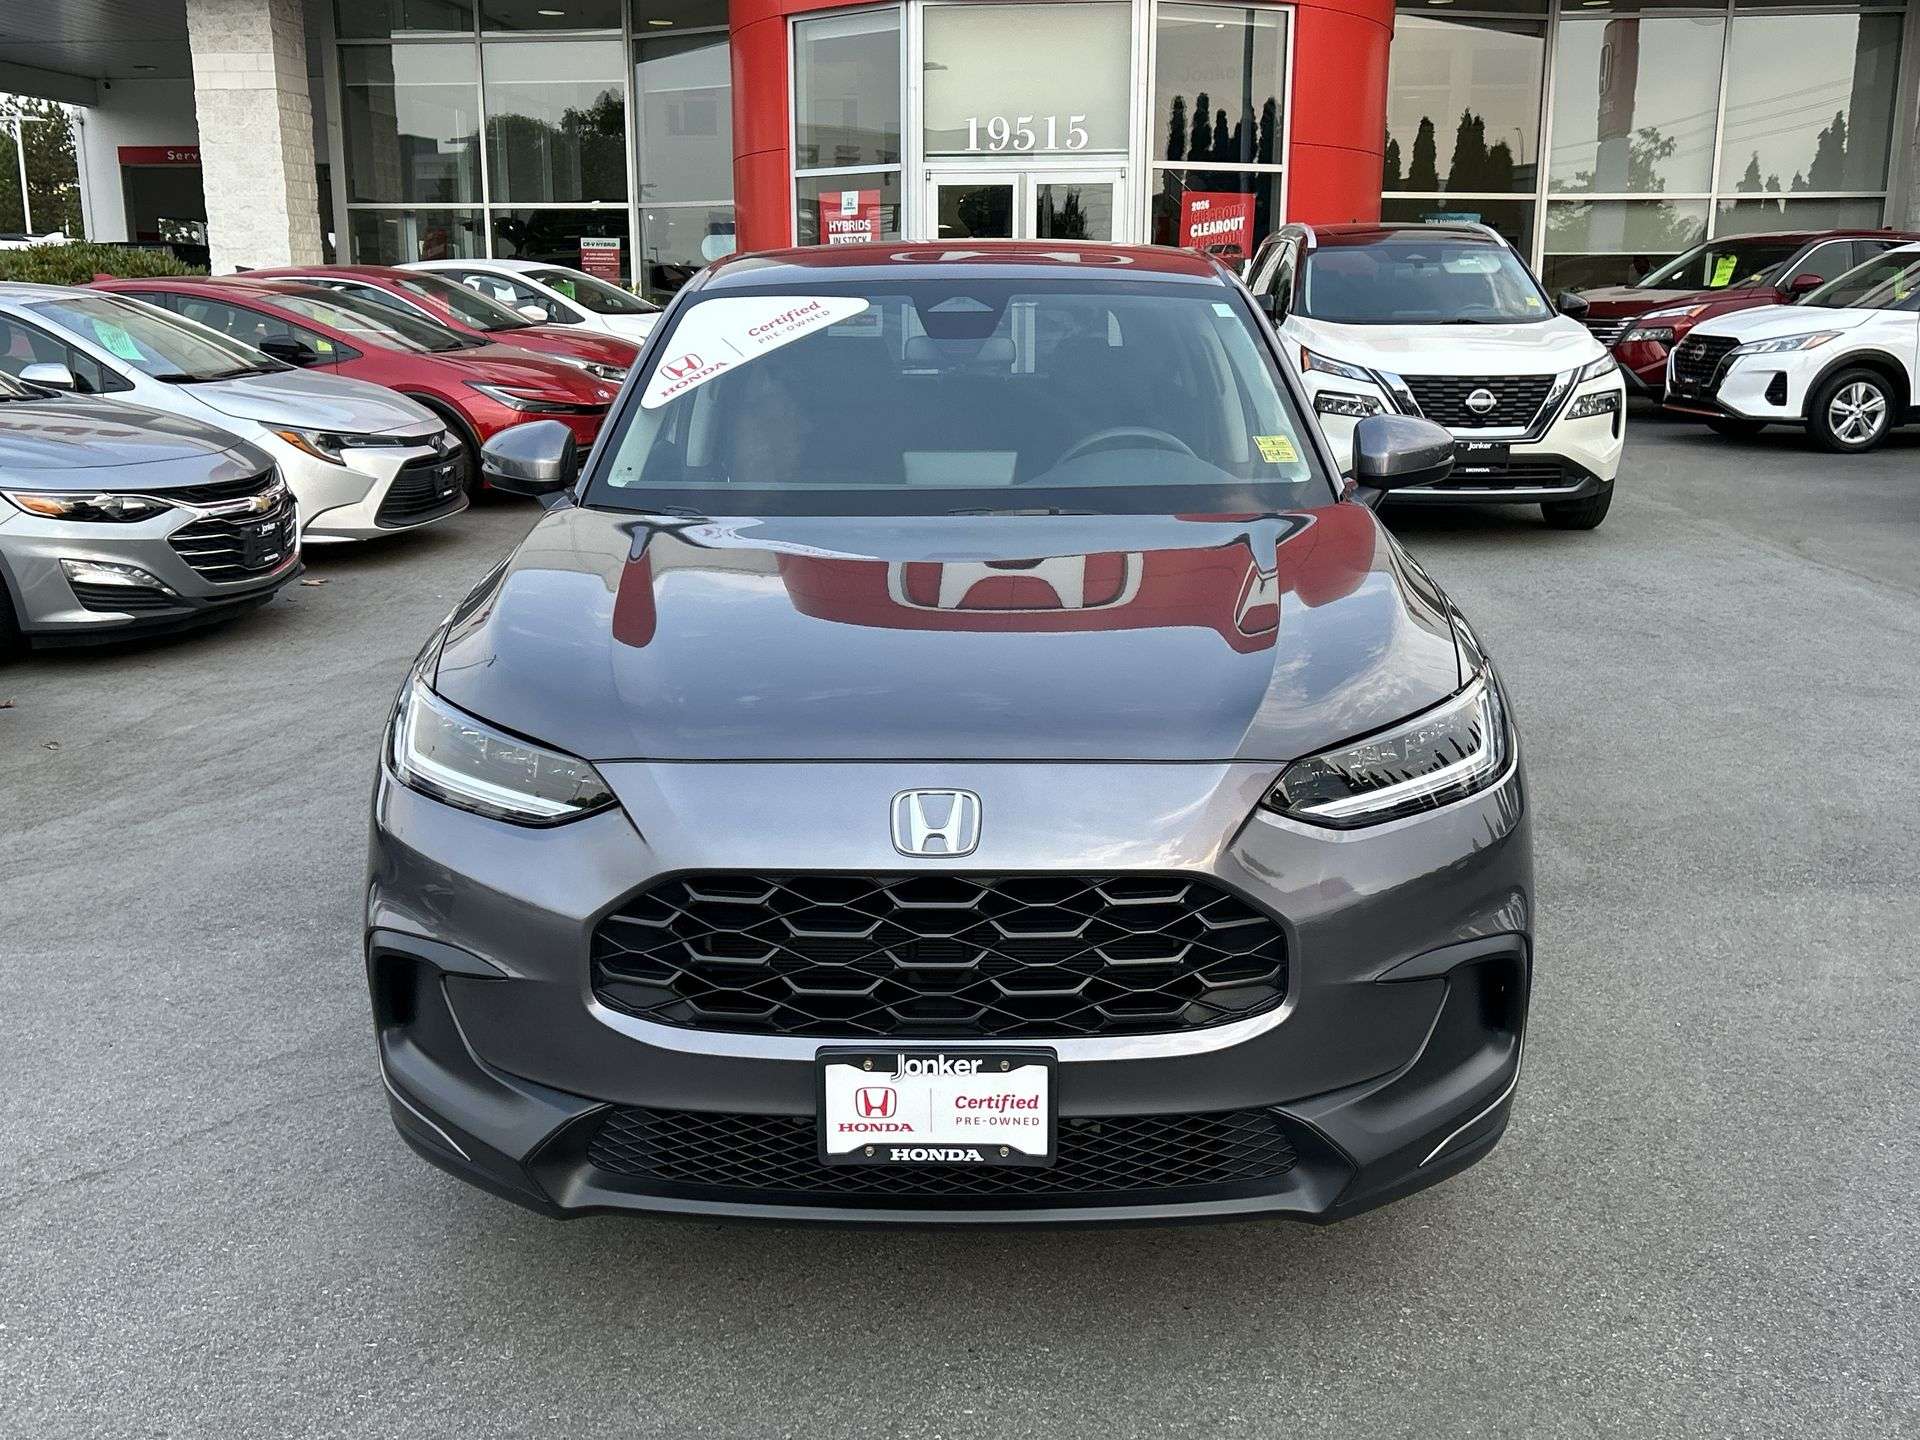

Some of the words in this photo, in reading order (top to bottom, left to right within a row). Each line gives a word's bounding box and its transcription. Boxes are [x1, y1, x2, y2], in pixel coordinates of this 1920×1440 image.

[964, 114, 1089, 151] 19515
[828, 219, 871, 233] HYBRIDS
[1190, 216, 1246, 238] CLEAROUT
[748, 301, 822, 337] Certified
[758, 310, 831, 344] PRE-OWNED
[661, 361, 729, 397] HONDA
[890, 1053, 983, 1082] Jonker
[954, 1094, 1039, 1113] Certified
[838, 1123, 914, 1132] HONDA
[955, 1116, 1040, 1126] PRE-OWNED
[890, 1148, 984, 1162] HONDA
